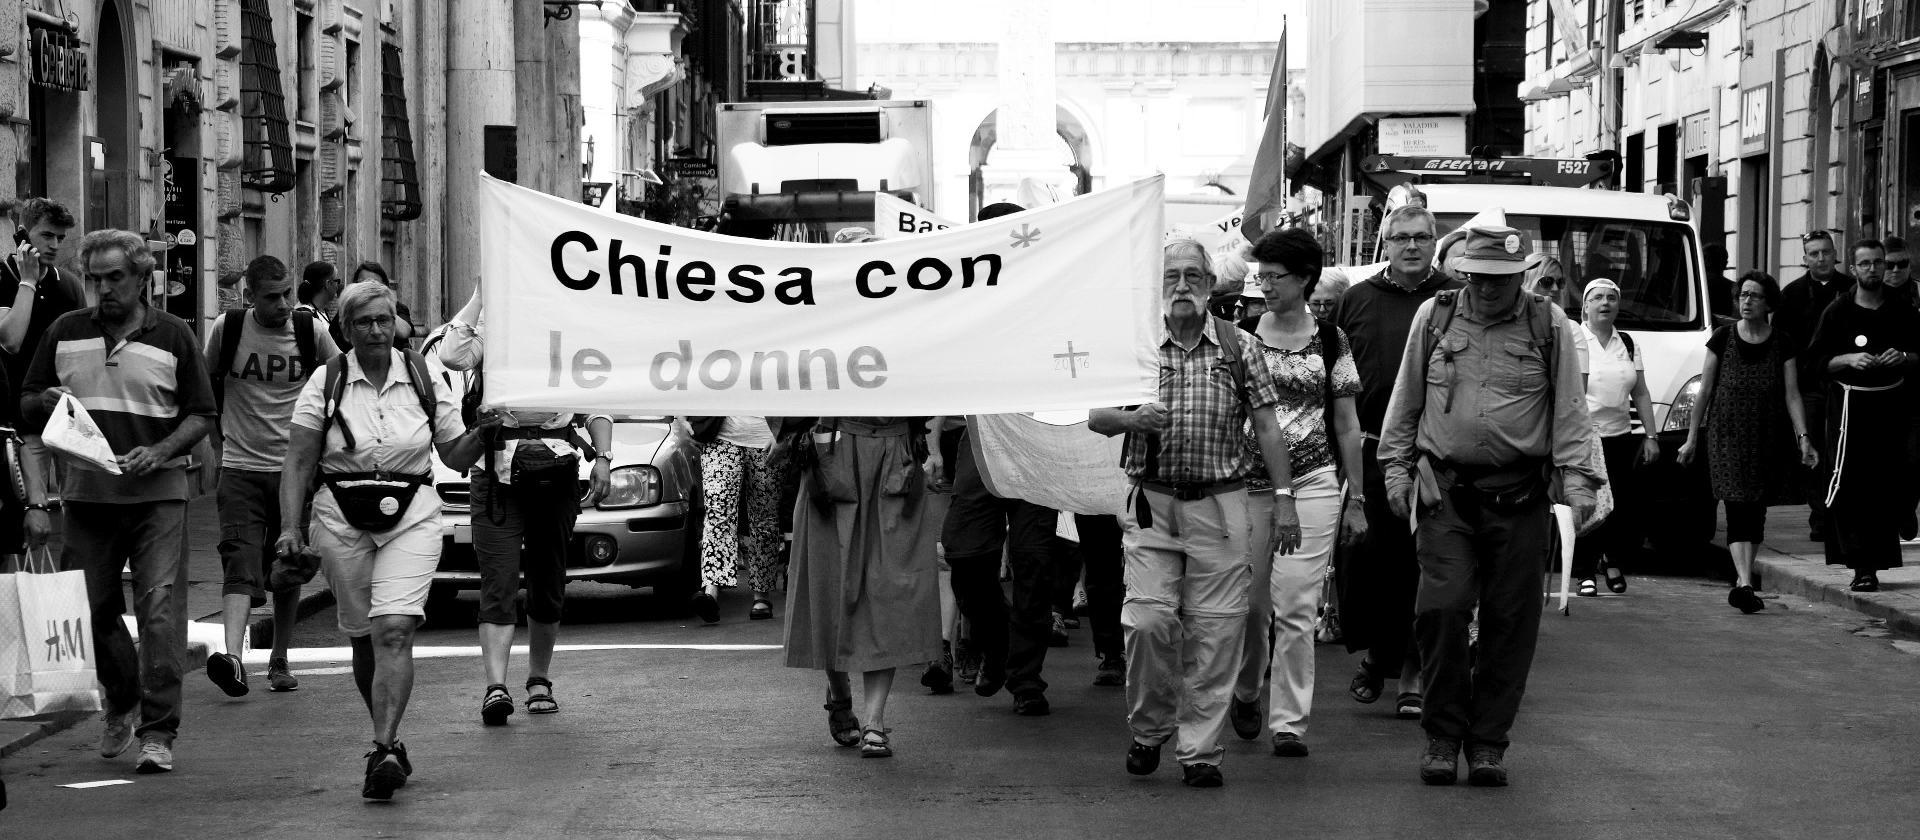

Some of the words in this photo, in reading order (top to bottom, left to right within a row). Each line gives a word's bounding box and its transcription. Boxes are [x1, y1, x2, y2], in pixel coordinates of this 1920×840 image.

[41, 28, 88, 91] Gelateria
[1557, 160, 1590, 174] F527
[550, 230, 816, 306] Chiesa
[855, 253, 1002, 299] con
[547, 330, 612, 389] le
[649, 339, 889, 391] donne
